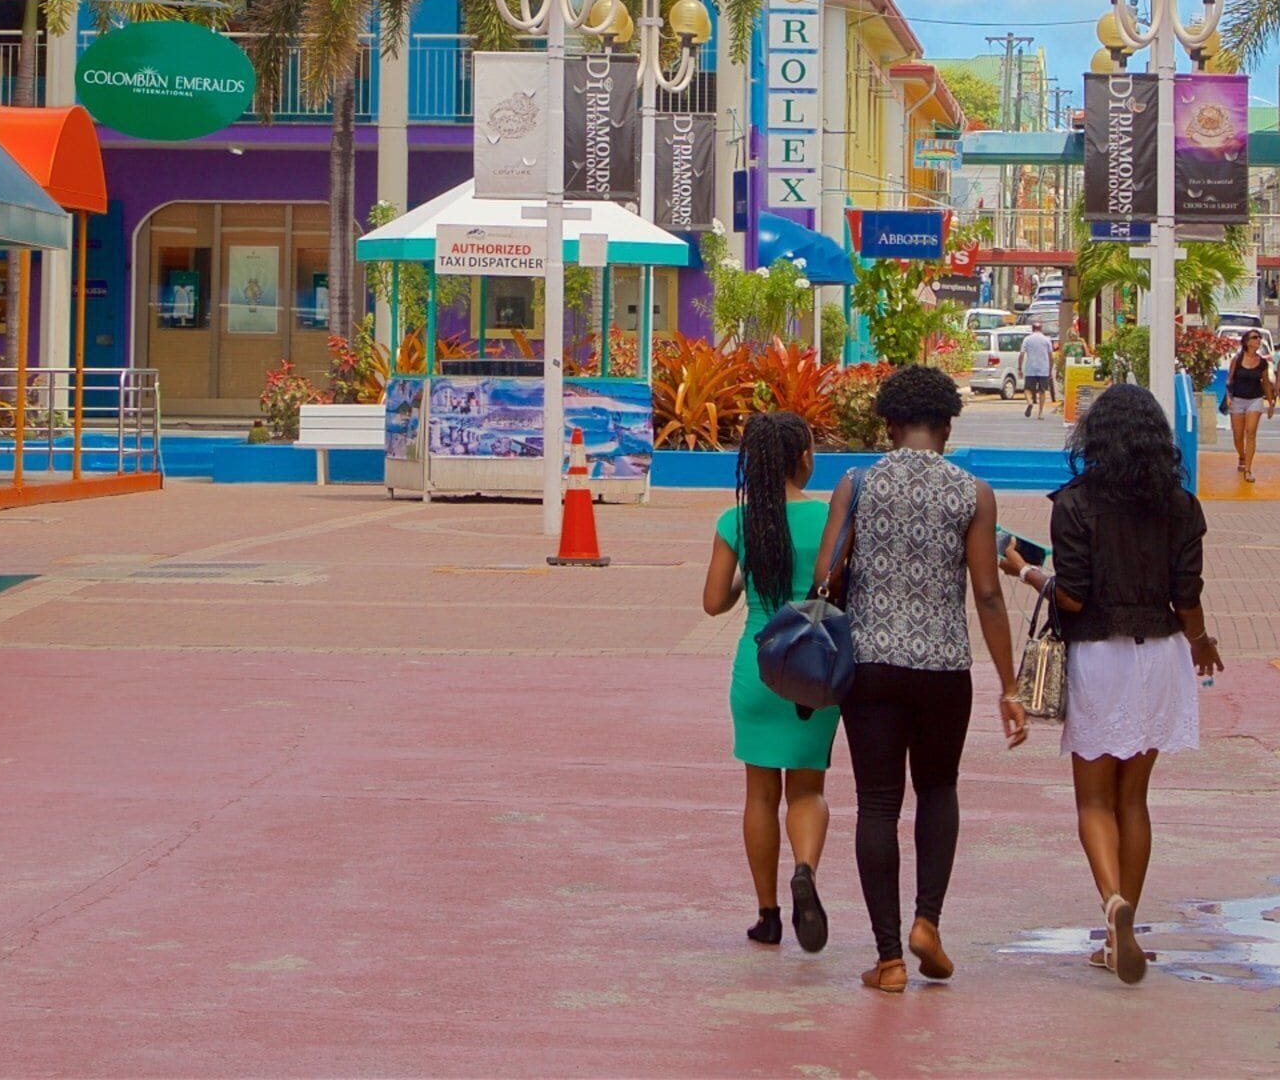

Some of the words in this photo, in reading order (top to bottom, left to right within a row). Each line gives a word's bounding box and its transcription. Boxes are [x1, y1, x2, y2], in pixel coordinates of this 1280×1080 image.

[83, 69, 169, 88] COLOMBIAN
[175, 75, 246, 94] EMERALDS
[132, 87, 194, 98] INTERNATIONAL
[780, 19, 810, 202] ROLEX
[586, 92, 596, 193] INTERNATIONAL
[595, 92, 611, 194] DIAMONDS
[1108, 112, 1119, 214] INTERNATIONAL
[1118, 112, 1134, 215] DIAMONDS
[672, 144, 681, 225] INTERNATIONAL
[680, 144, 693, 226] DIAMONDS
[439, 255, 466, 267] TAXI
[468, 256, 544, 269] DISPATCHER
[451, 243, 532, 256] AUTHORIZED
